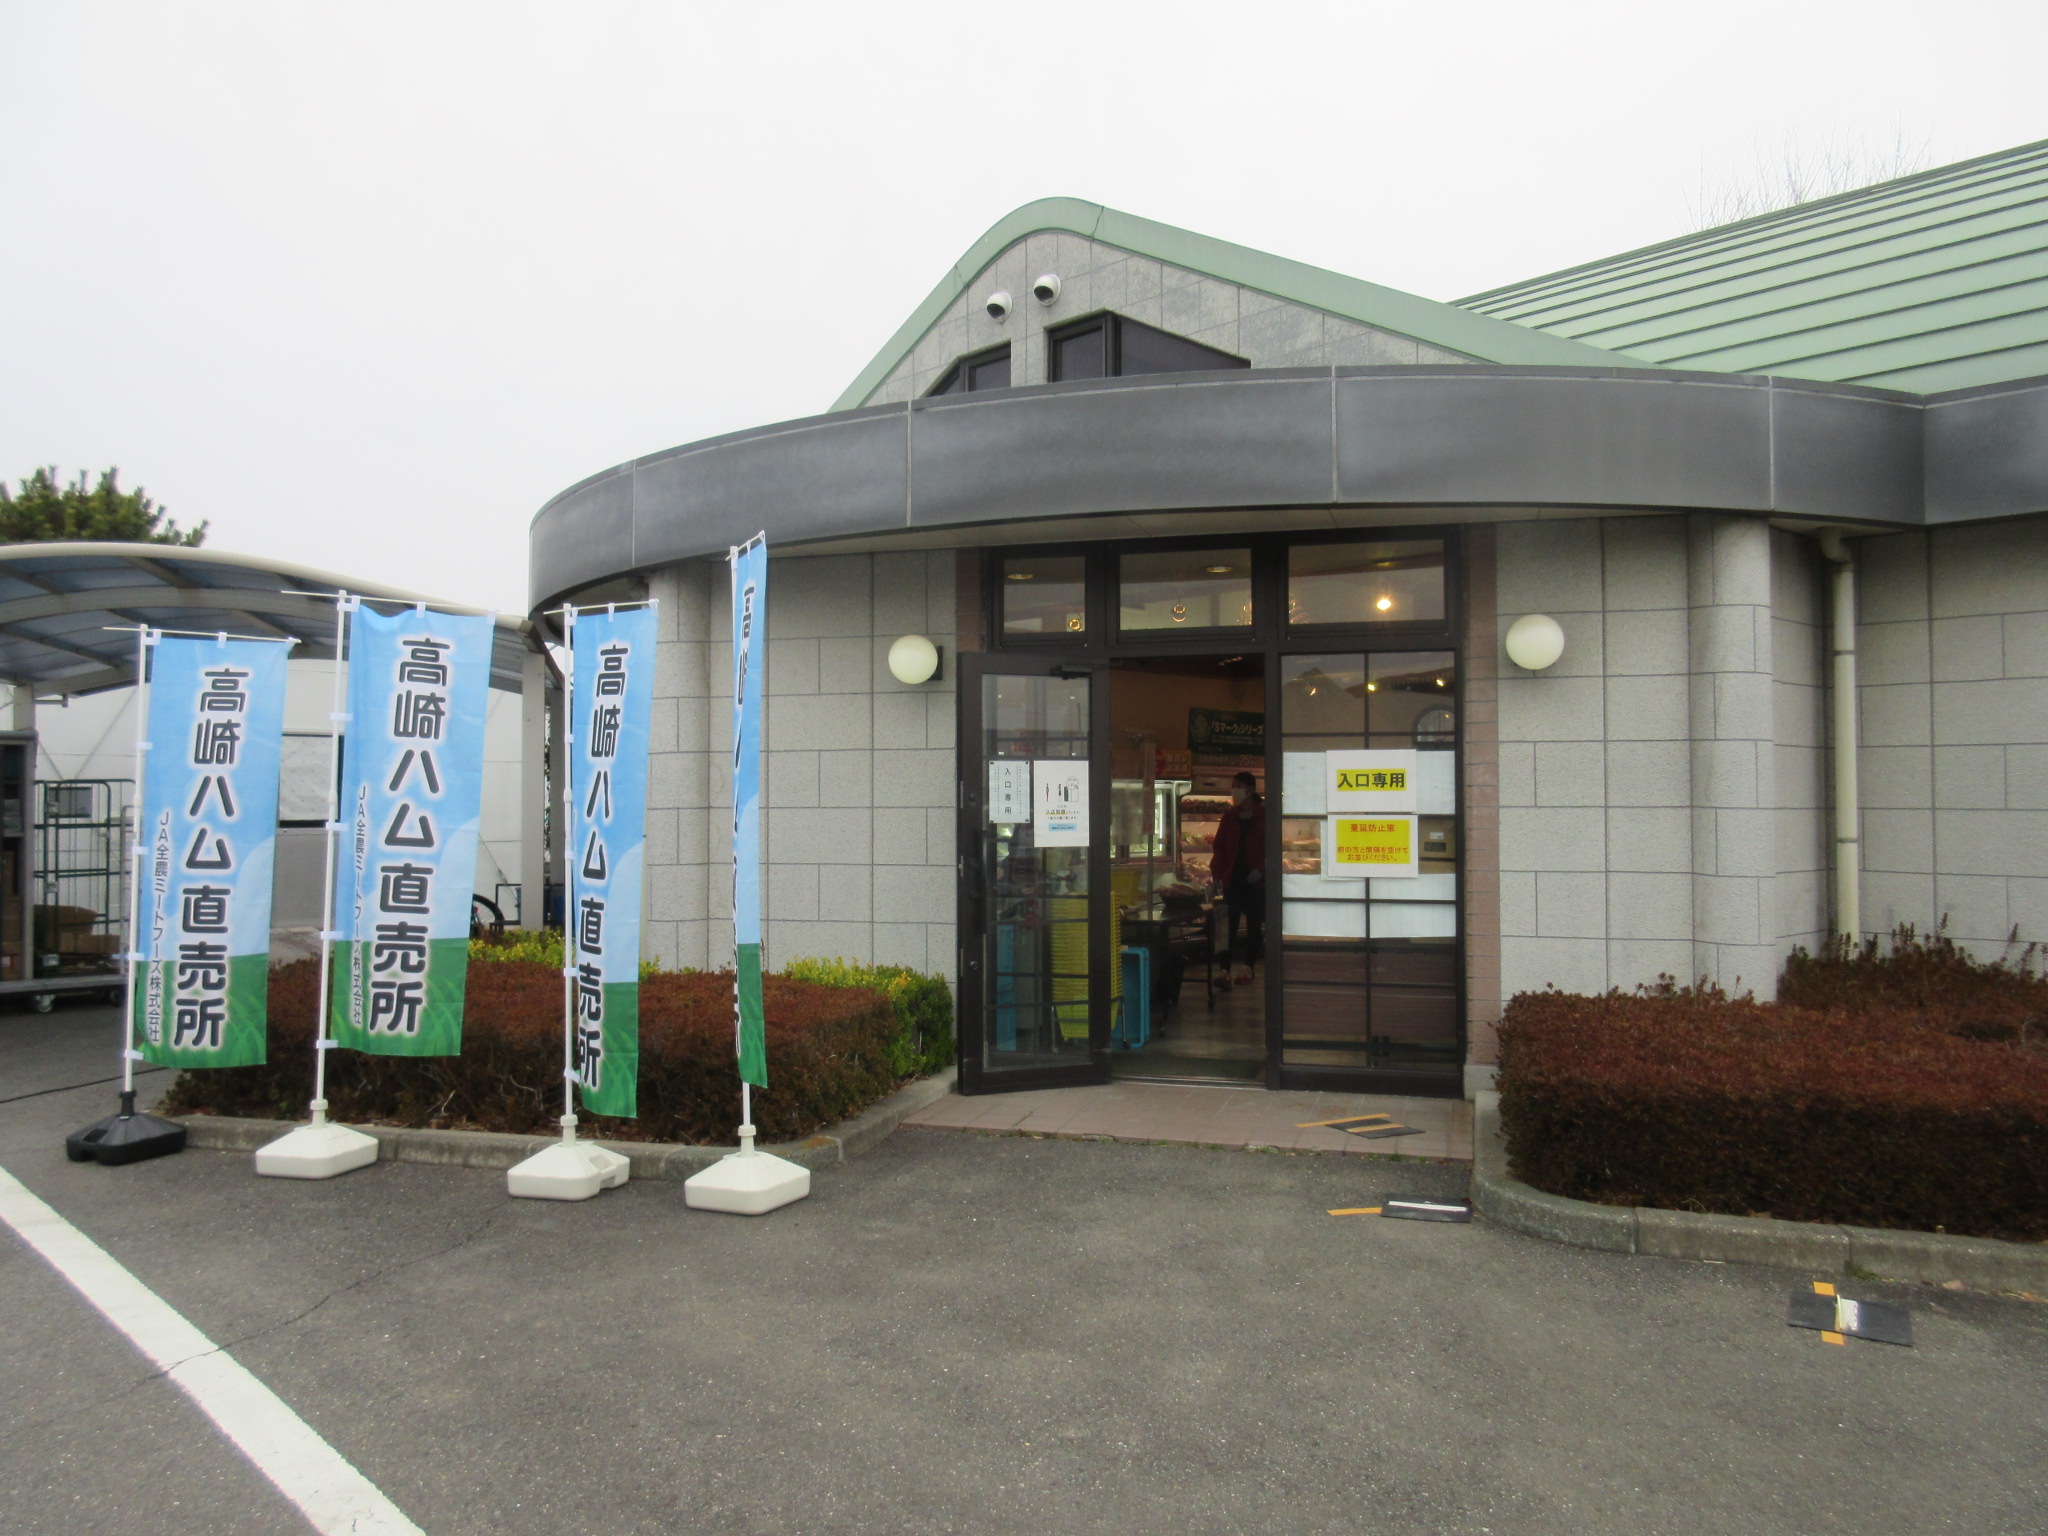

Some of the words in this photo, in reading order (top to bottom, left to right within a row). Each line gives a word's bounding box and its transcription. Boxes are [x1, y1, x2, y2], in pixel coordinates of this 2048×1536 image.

[147, 810, 170, 1043] JA全農ミートフーズ株式会社
[173, 667, 250, 1047] 高崎ハム直売所
[368, 637, 451, 1032] 高崎ハム直売所
[580, 643, 629, 1088] 高崎ハム直売所
[1004, 767, 1012, 815] 入口専用
[1336, 772, 1406, 789] 入口専用
